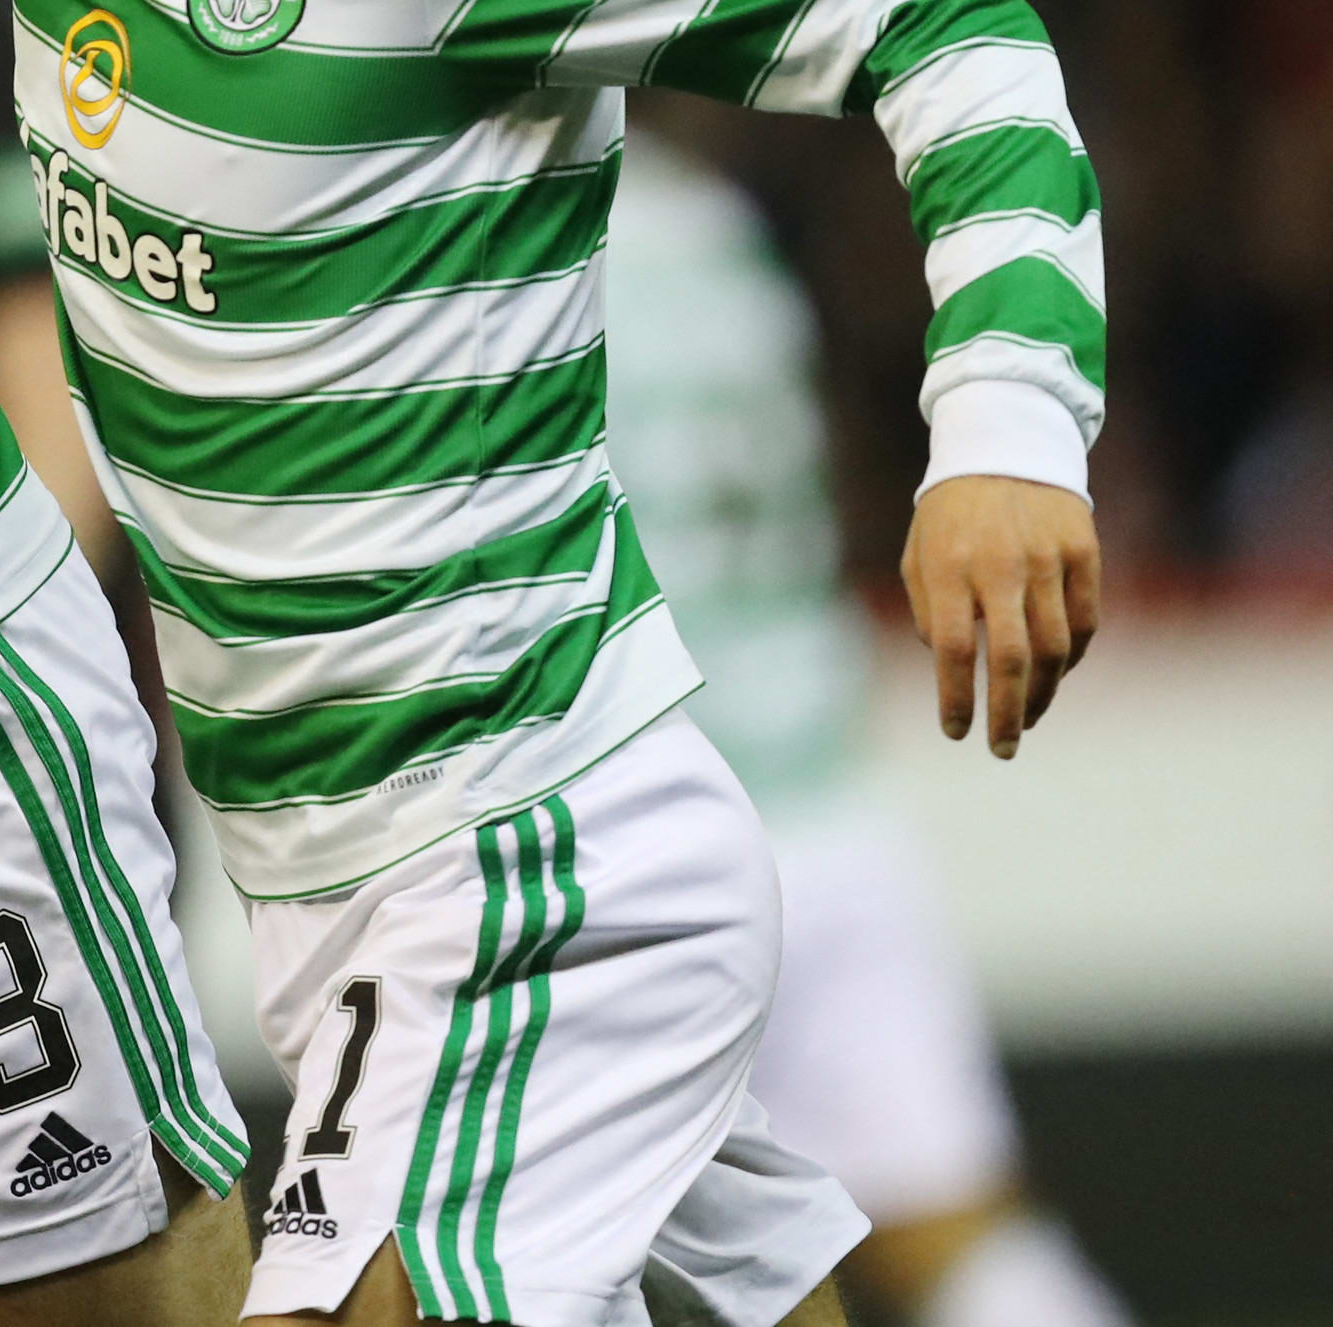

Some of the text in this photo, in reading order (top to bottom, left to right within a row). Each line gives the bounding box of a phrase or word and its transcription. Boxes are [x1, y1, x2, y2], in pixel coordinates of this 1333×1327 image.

[20, 120, 218, 315] afabet
[376, 766, 445, 795] AEROREADY
[10, 1144, 112, 1198] adidas
